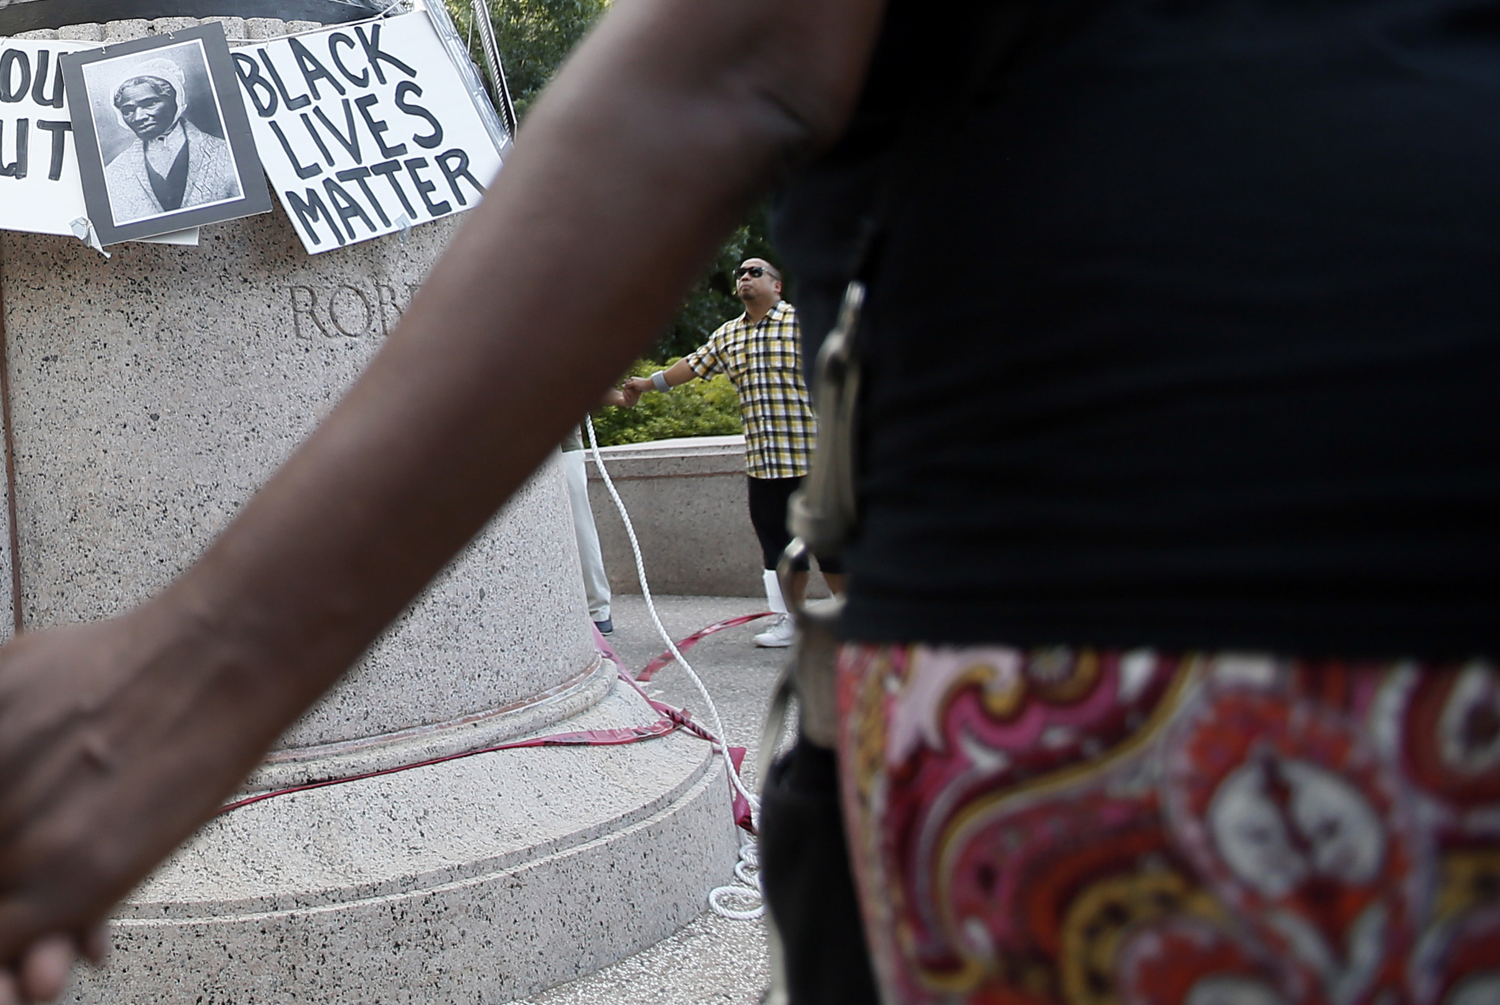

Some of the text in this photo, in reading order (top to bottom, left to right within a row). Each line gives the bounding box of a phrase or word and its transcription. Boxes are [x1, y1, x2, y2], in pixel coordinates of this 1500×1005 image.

[231, 24, 417, 117] BLACK
[268, 80, 443, 180] LIVES
[285, 148, 487, 246] MATTER
